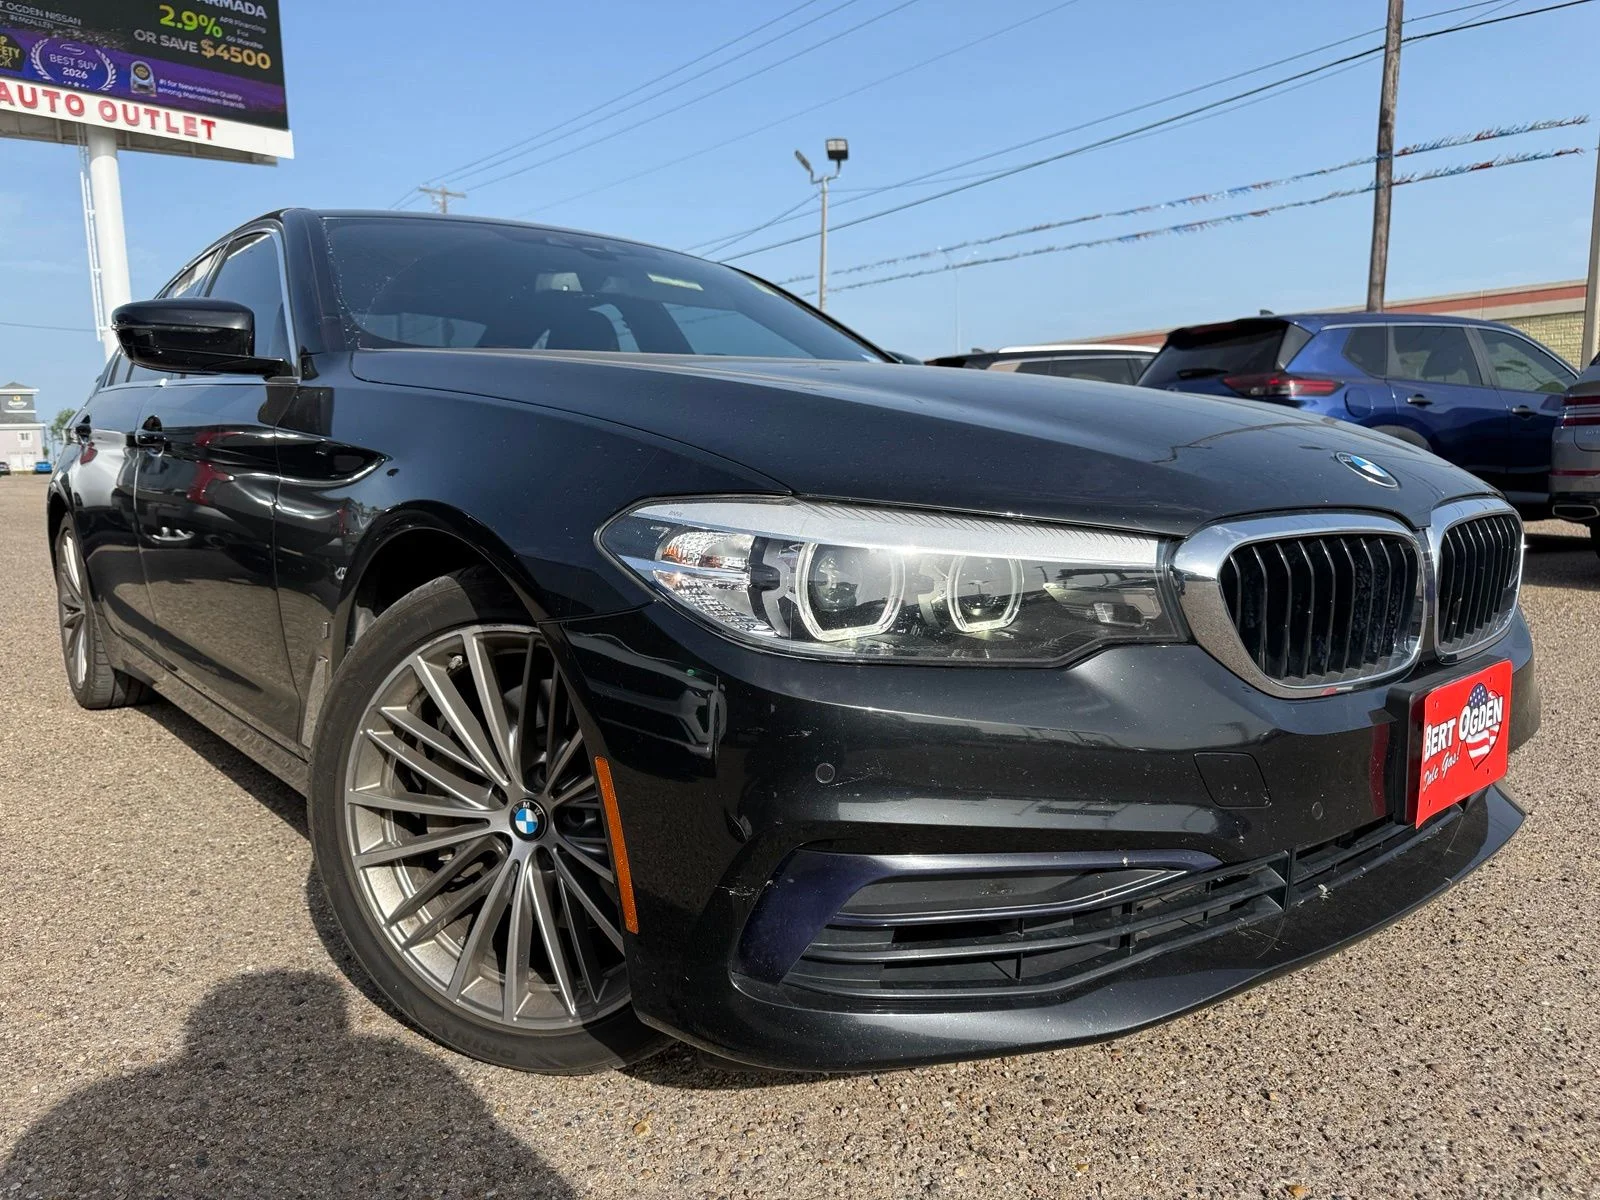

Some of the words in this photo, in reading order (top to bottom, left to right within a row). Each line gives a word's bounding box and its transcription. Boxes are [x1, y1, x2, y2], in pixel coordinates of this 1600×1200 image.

[45, 11, 81, 25] NISSAN
[159, 4, 223, 38] 2.9%
[49, 53, 76, 66] BEST
[77, 59, 98, 71] SUV
[133, 29, 157, 45] OR
[160, 35, 199, 54] SAVE
[200, 38, 272, 70] $4500
[62, 67, 89, 80] 2026
[0, 81, 85, 117] AUTO
[98, 99, 217, 141] OUTLET
[1424, 717, 1457, 763] BERT
[1458, 696, 1504, 741] OGDEN
[512, 801, 543, 816] BMW
